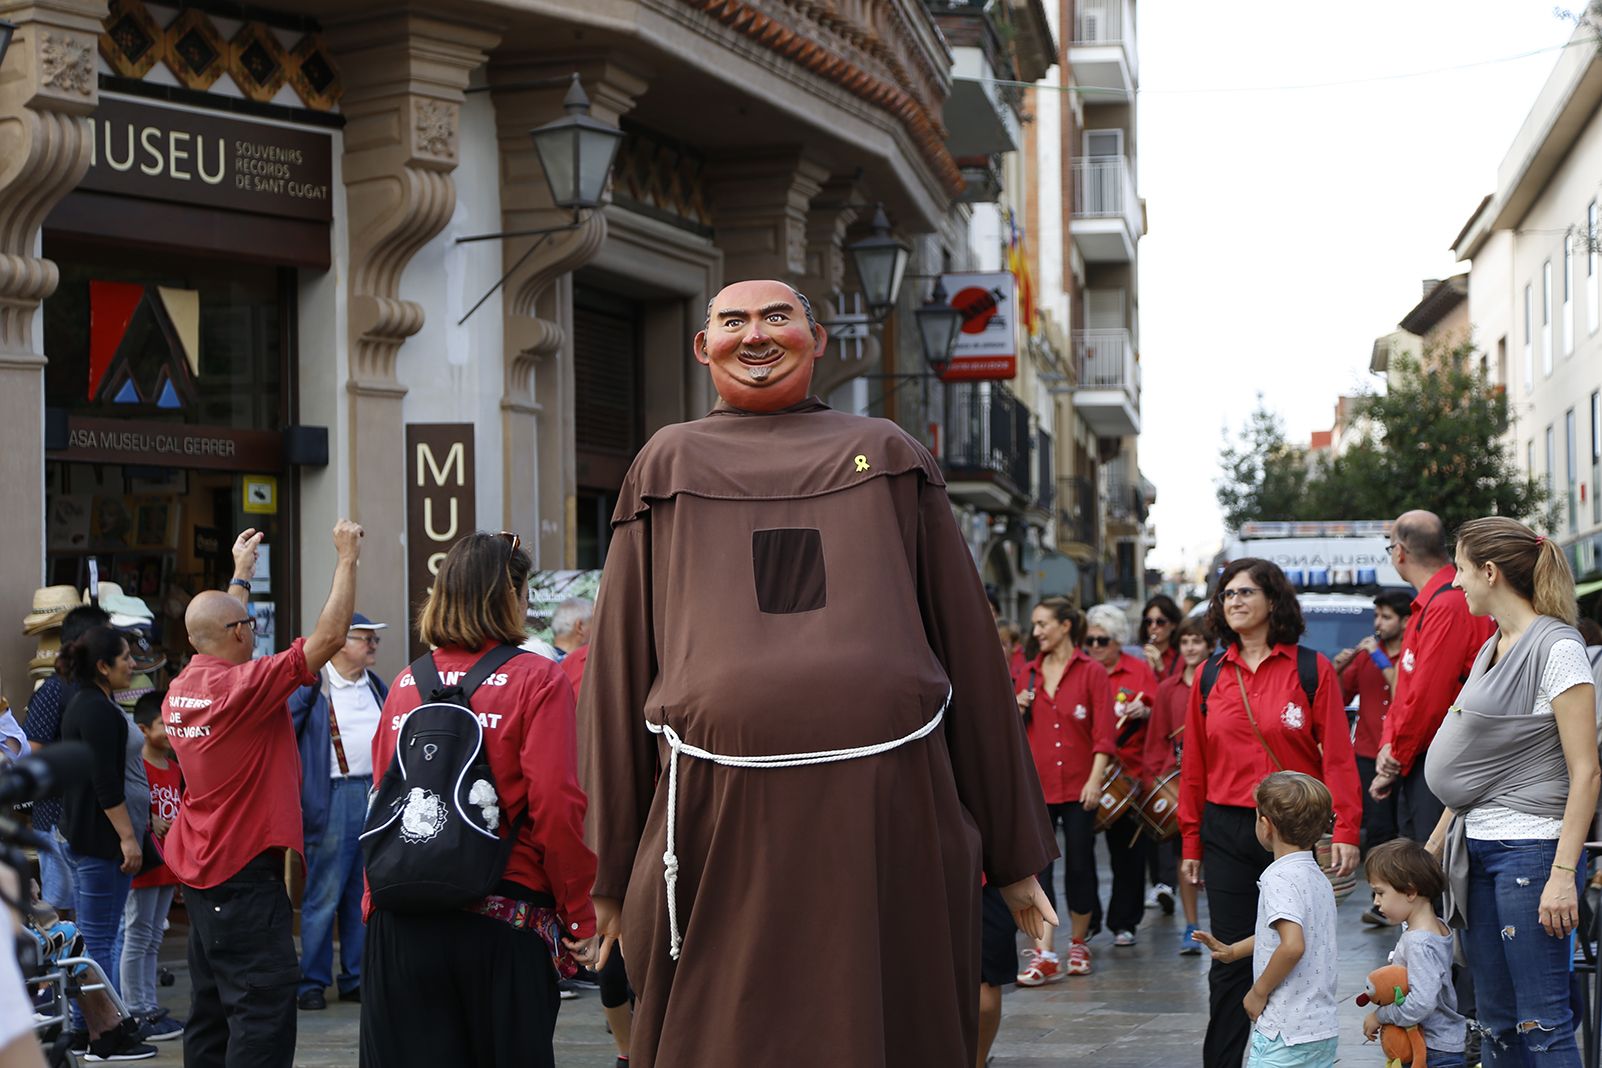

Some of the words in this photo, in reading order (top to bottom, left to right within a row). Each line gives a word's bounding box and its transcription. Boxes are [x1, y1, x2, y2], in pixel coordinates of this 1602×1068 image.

[235, 140, 303, 165] SOUVENIRS
[235, 158, 290, 179] RECORDS
[235, 174, 251, 190] DE
[254, 176, 285, 194] SANT
[287, 181, 327, 200] CUGAT
[183, 436, 236, 457] GERRER
